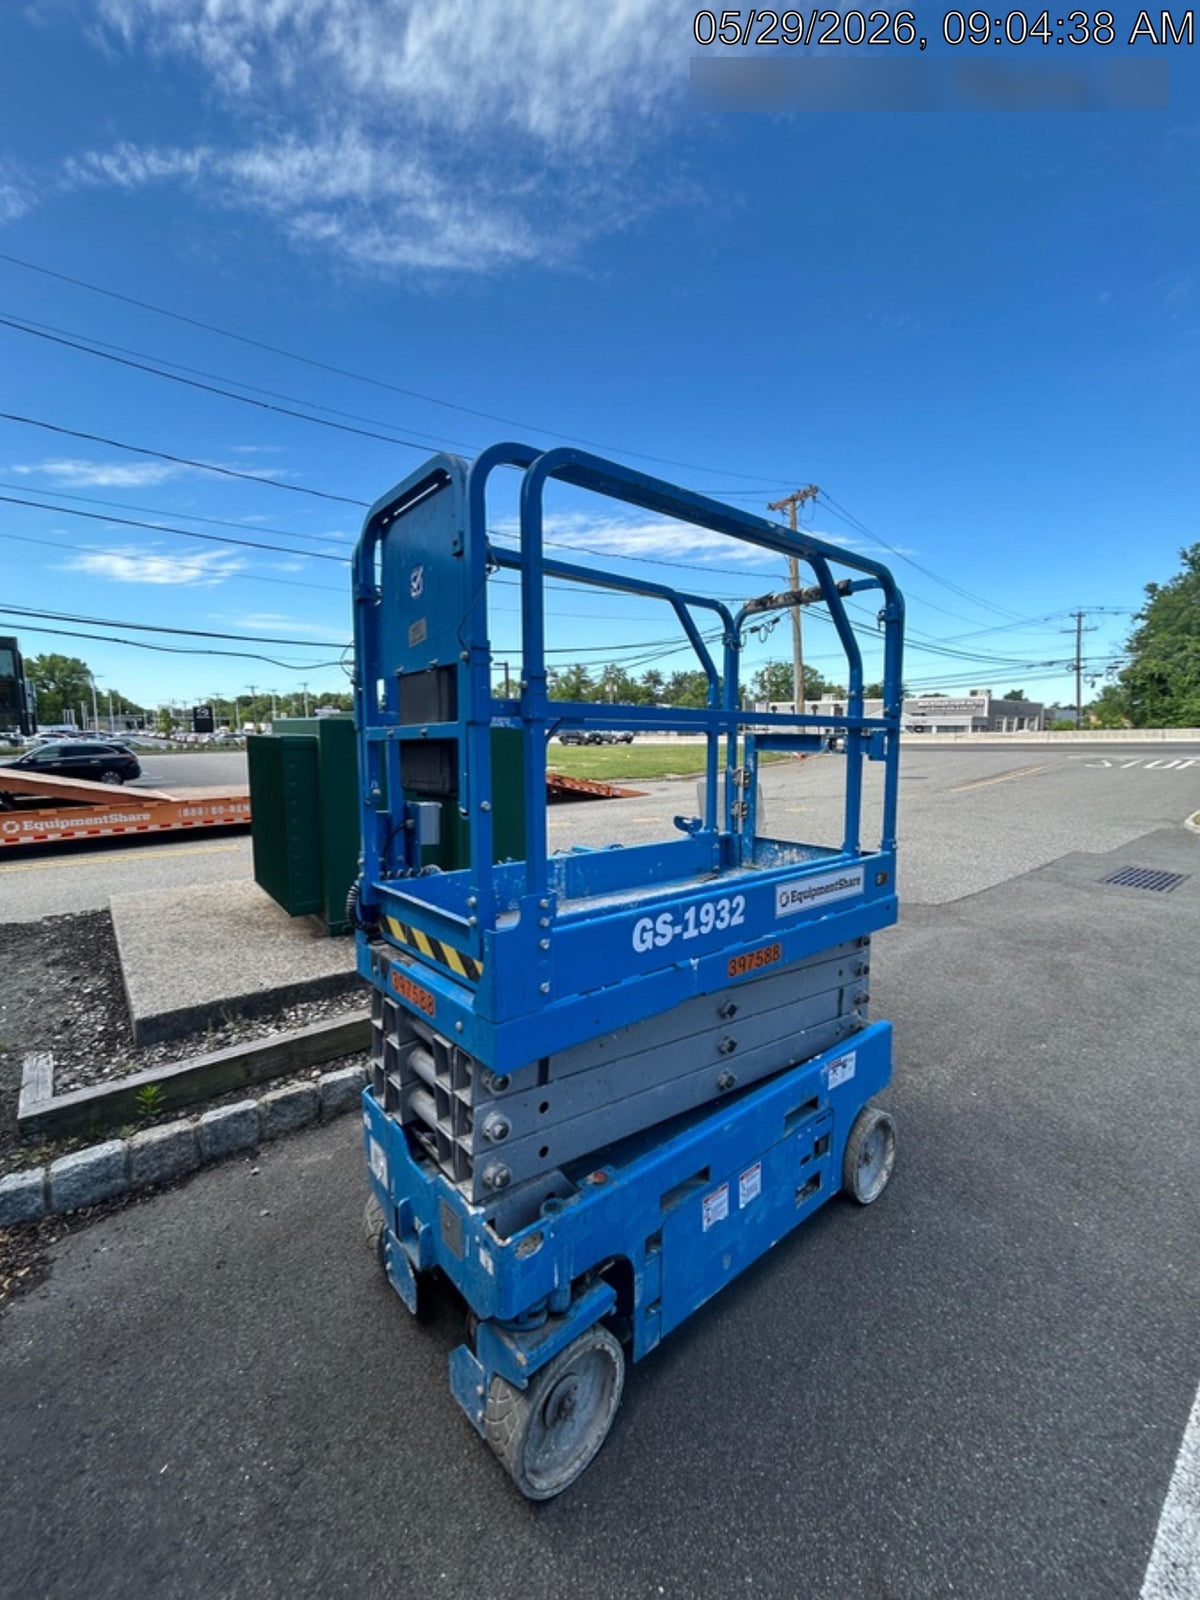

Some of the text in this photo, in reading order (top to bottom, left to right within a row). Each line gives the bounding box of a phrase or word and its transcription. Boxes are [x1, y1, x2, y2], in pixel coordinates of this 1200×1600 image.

[22, 812, 151, 832] EquipmentShare
[790, 873, 862, 904] EquipmentShare
[632, 895, 746, 953] GS-1932
[728, 944, 780, 976] 397588
